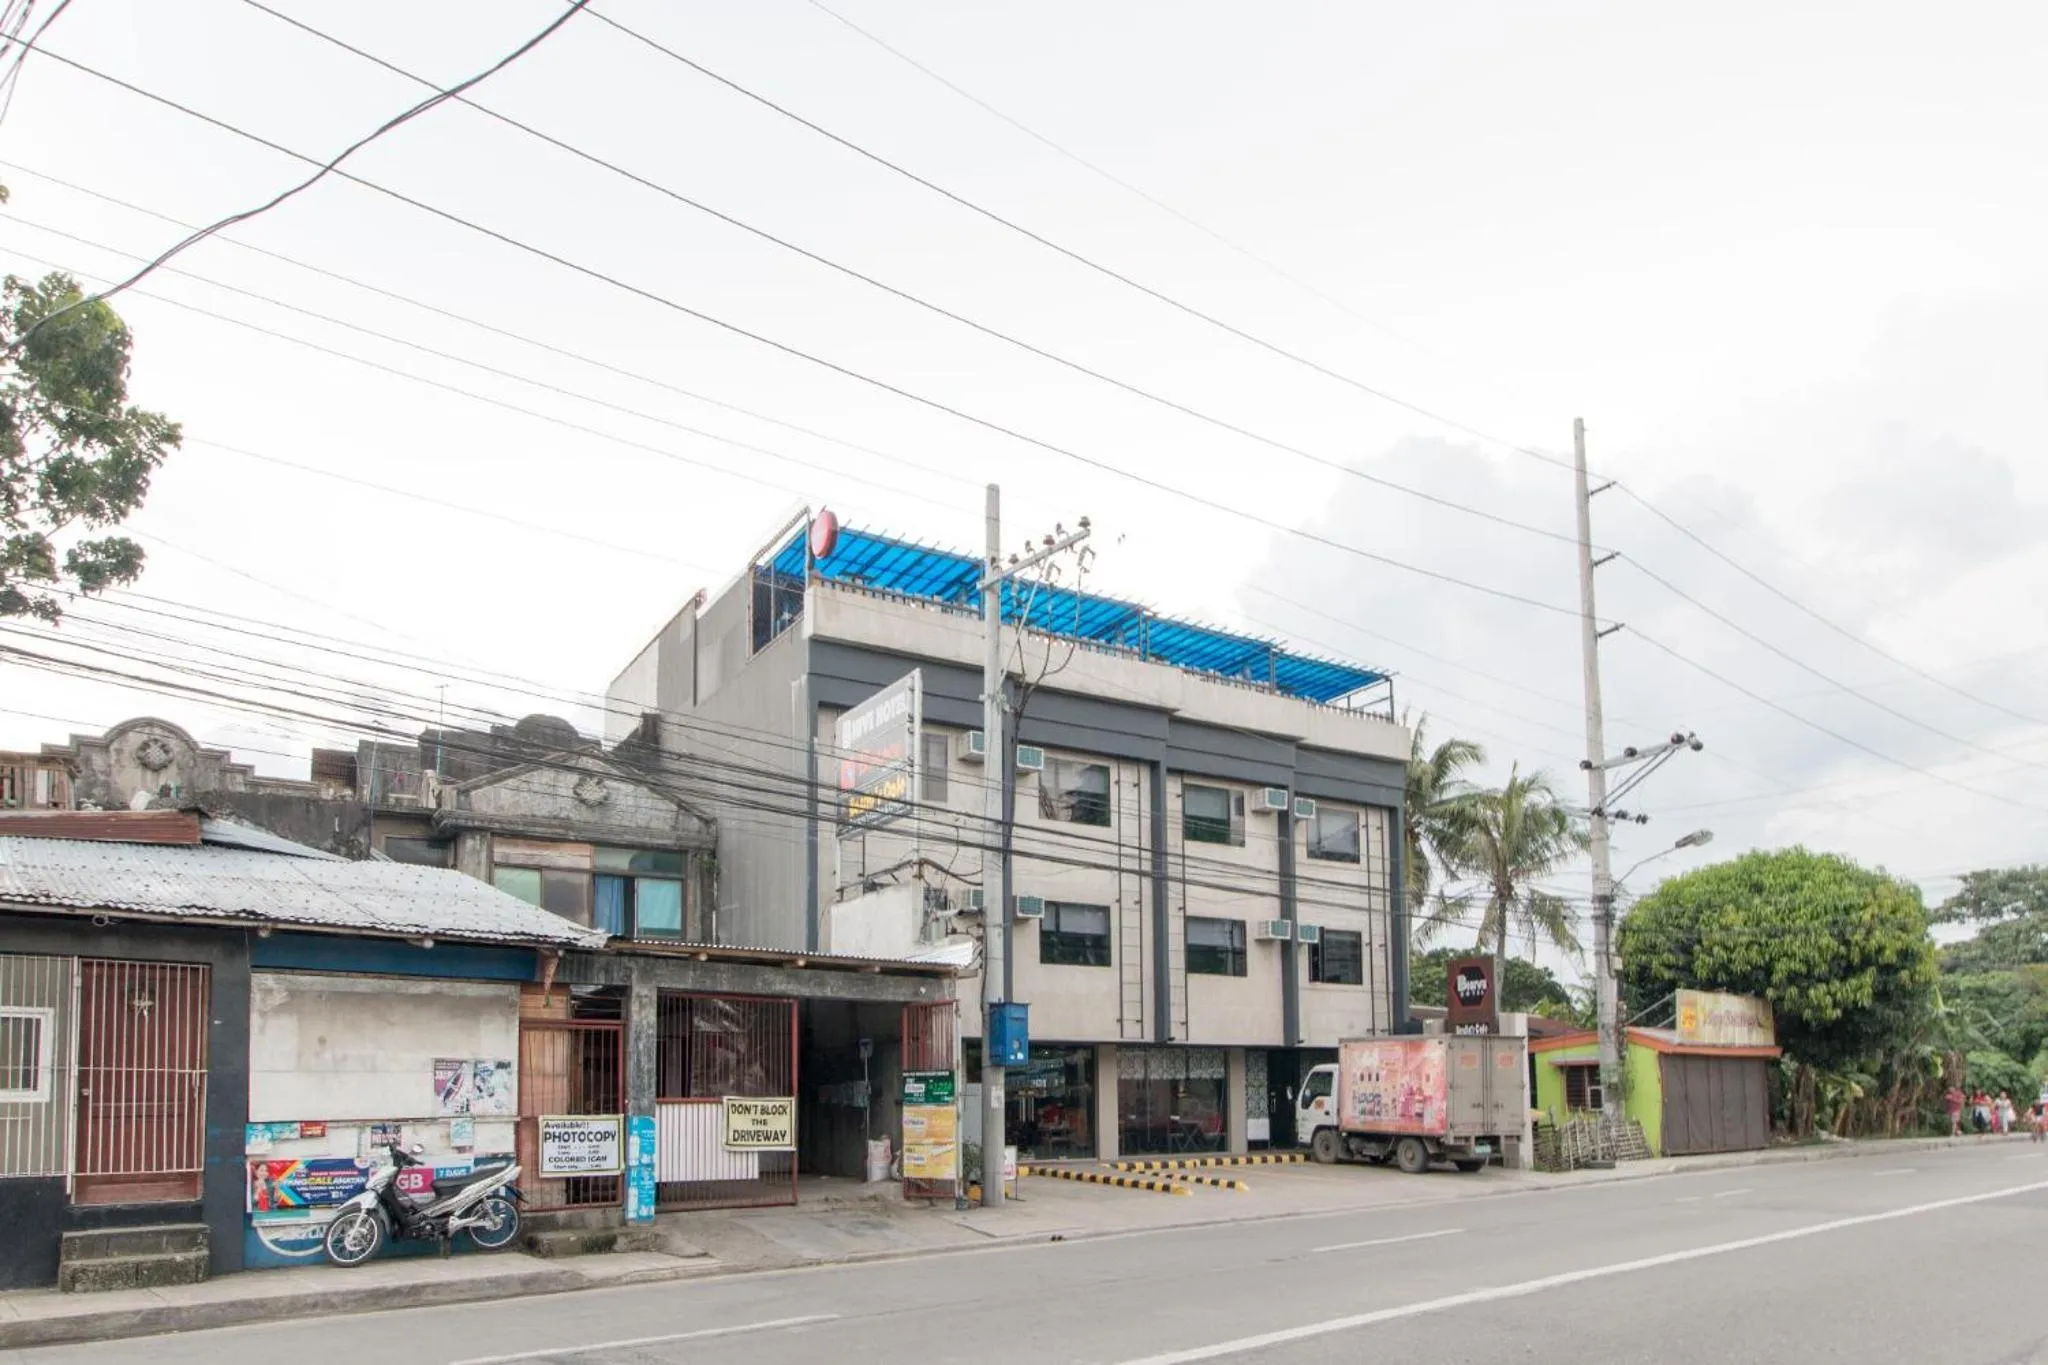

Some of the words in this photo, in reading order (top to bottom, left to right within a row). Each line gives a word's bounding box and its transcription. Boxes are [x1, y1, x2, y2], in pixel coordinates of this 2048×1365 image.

[760, 1104, 788, 1115] BLOCK
[752, 1118, 768, 1126] THE
[543, 1131, 617, 1143] PHOTOCOPY
[732, 1129, 787, 1142] DRIVEWAY
[396, 1174, 424, 1190] GB
